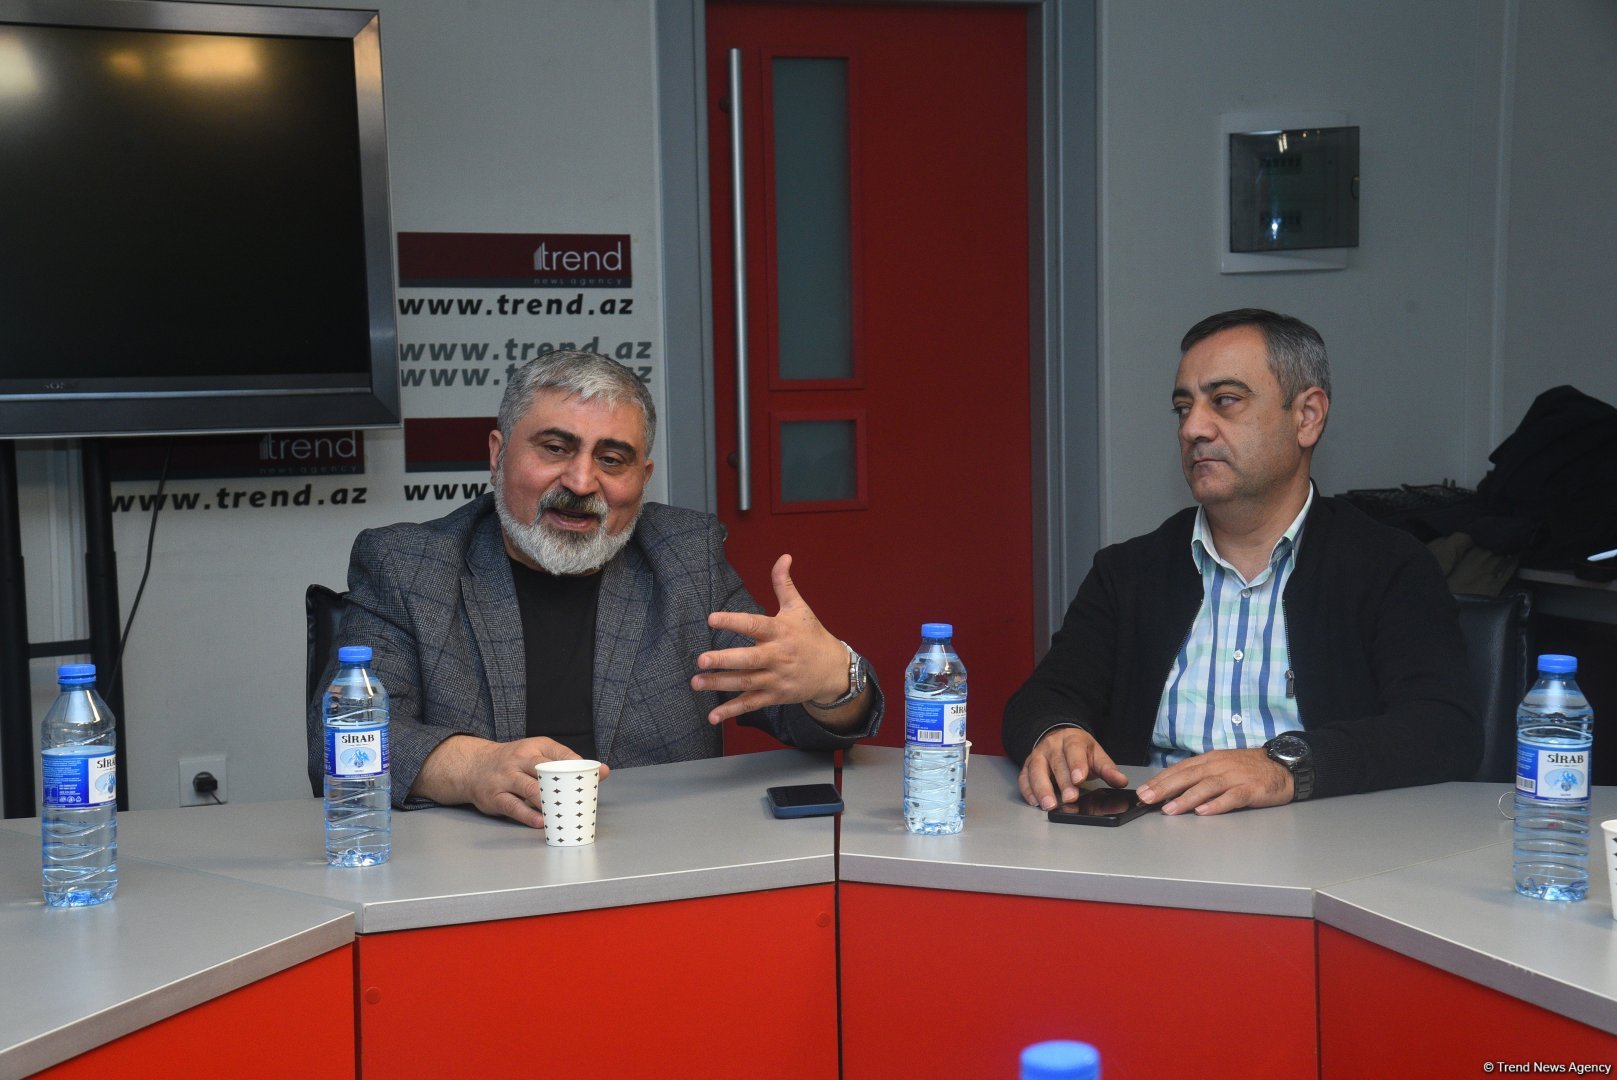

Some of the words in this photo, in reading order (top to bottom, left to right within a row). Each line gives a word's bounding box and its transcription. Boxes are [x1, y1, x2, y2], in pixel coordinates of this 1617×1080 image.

[540, 240, 622, 271] trend
[570, 278, 622, 286] agency
[398, 293, 634, 315] www.trend.az
[267, 430, 357, 460] trend
[112, 484, 368, 512] www.trend.az
